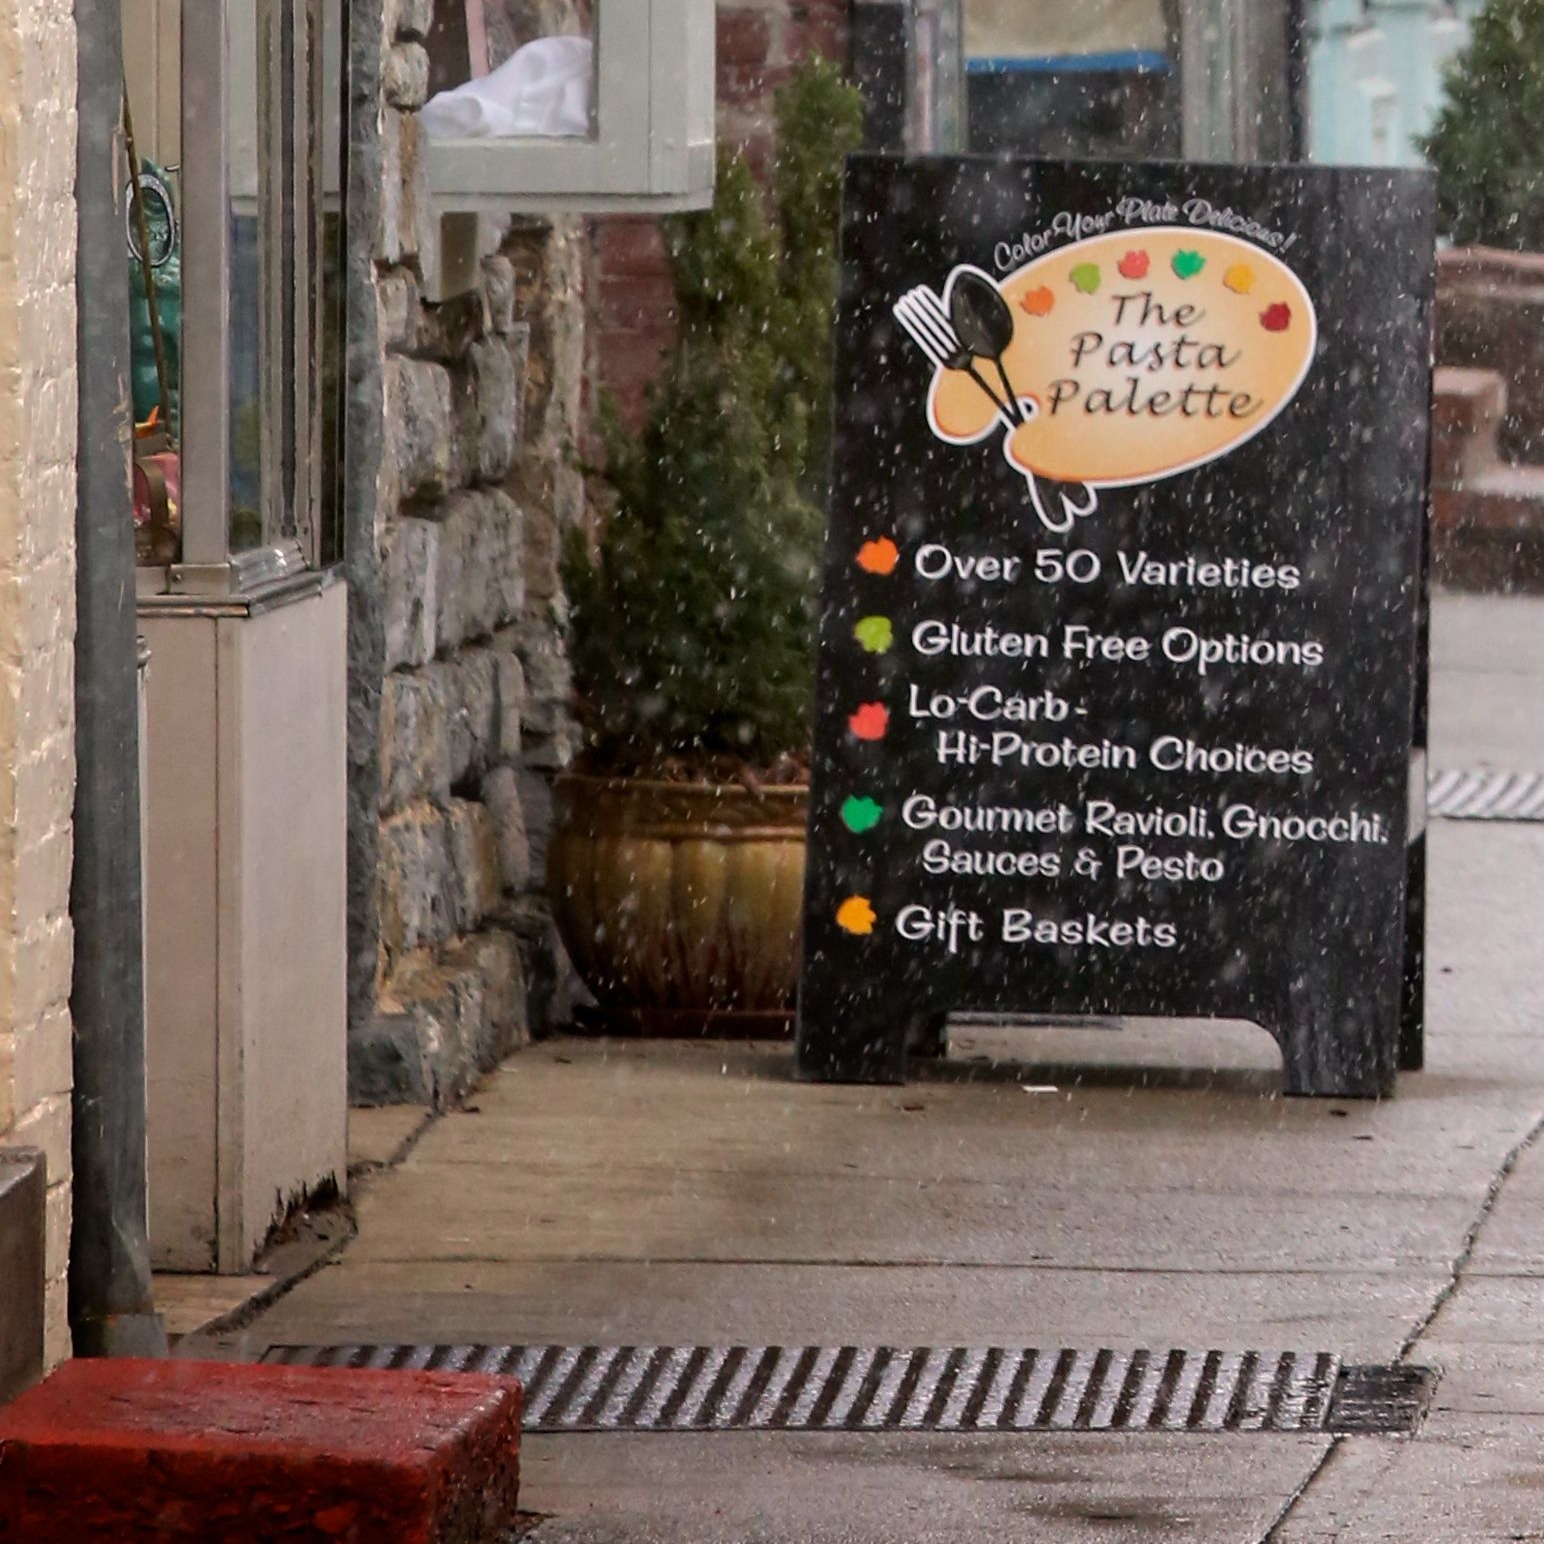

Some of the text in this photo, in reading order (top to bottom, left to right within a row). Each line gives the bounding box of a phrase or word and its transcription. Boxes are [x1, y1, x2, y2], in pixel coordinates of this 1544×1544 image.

[993, 195, 1299, 273] Color Your Plate Delicious!
[1110, 290, 1207, 328] The
[1070, 330, 1243, 372] Pasta
[1047, 375, 1264, 420] Palette
[914, 542, 1301, 591] Over 50 Varieties
[911, 619, 1324, 675] Gluten Free Options
[937, 729, 1314, 775] Hi-Protein Choices
[902, 794, 1074, 834] Gourmet
[922, 840, 1225, 882] Sauces & Pesto
[896, 904, 1177, 954] Gift Baskets
